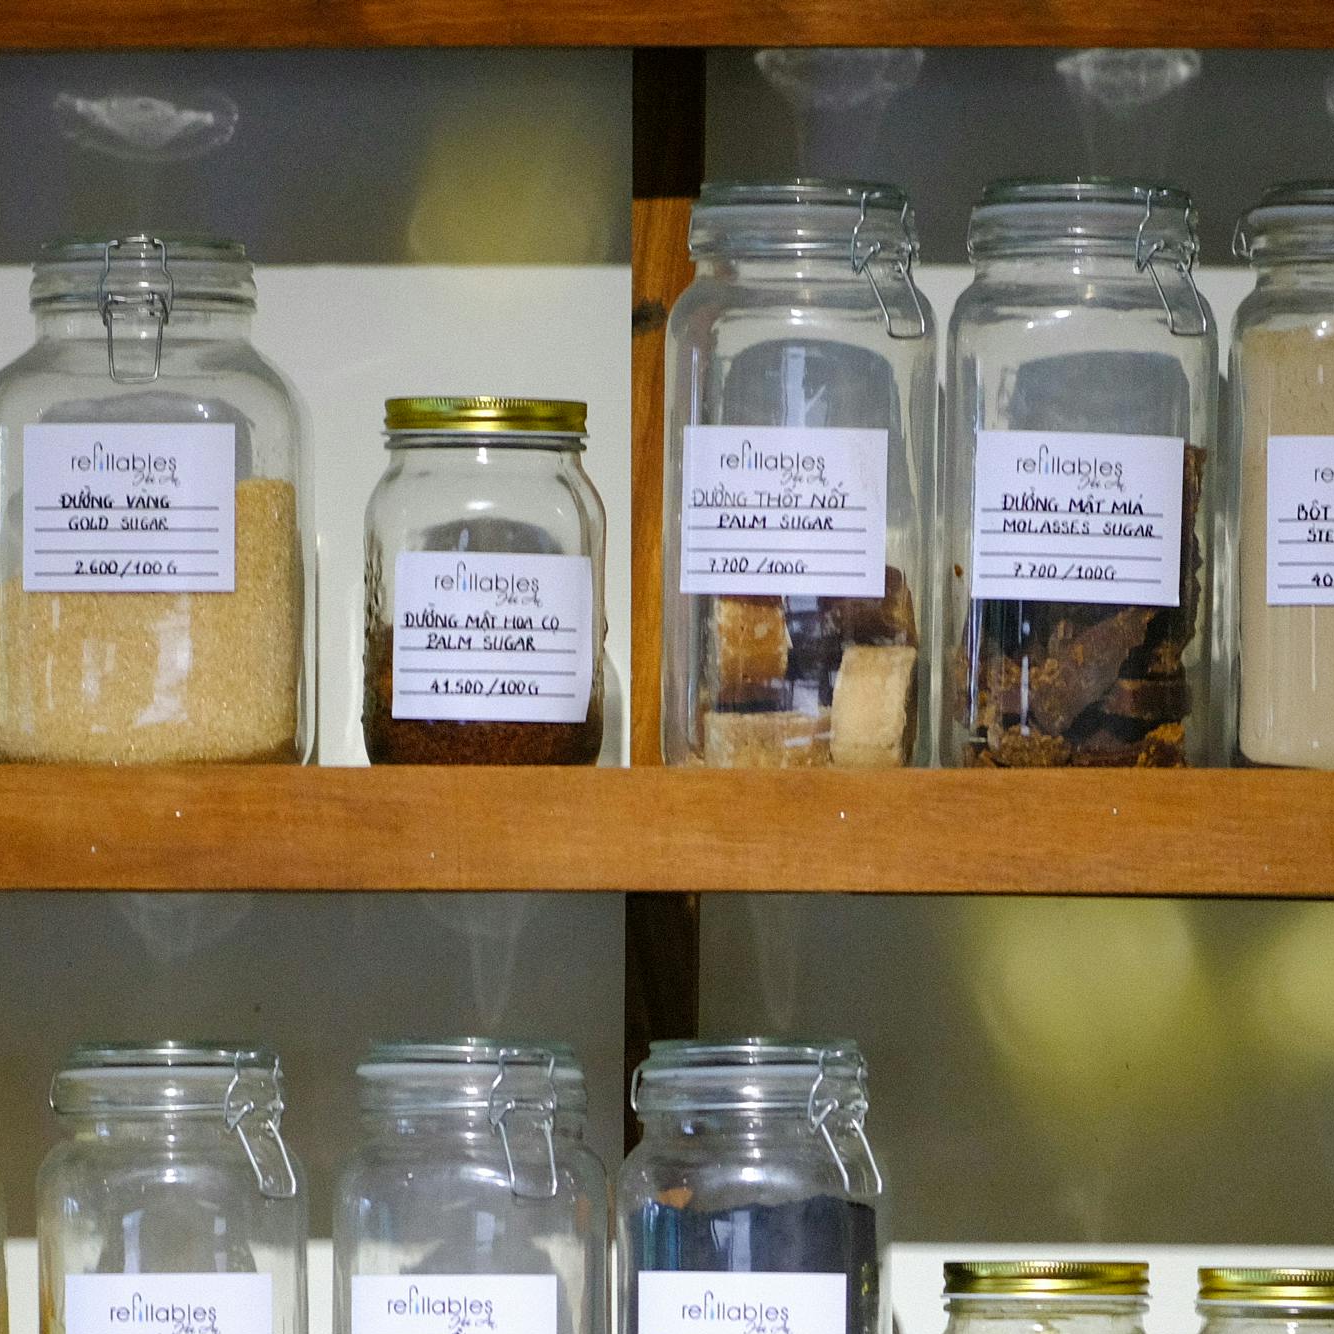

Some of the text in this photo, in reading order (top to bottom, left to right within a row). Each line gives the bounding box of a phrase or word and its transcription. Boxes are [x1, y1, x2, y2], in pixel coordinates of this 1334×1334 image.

[72, 441, 176, 476] refillables
[720, 440, 824, 471] refillables
[1017, 445, 1122, 477] refillables
[68, 516, 169, 531] GOLD SUGAR
[718, 515, 833, 530] PALM SUGAR
[1003, 520, 1154, 537] MOLASSES SUGAR
[435, 561, 539, 593] refillables
[504, 615, 533, 629] HOA
[427, 634, 535, 650] PALM SUGAR
[111, 1293, 216, 1323] refillables
[388, 1285, 492, 1315] refillables
[683, 1291, 788, 1320] refillables
